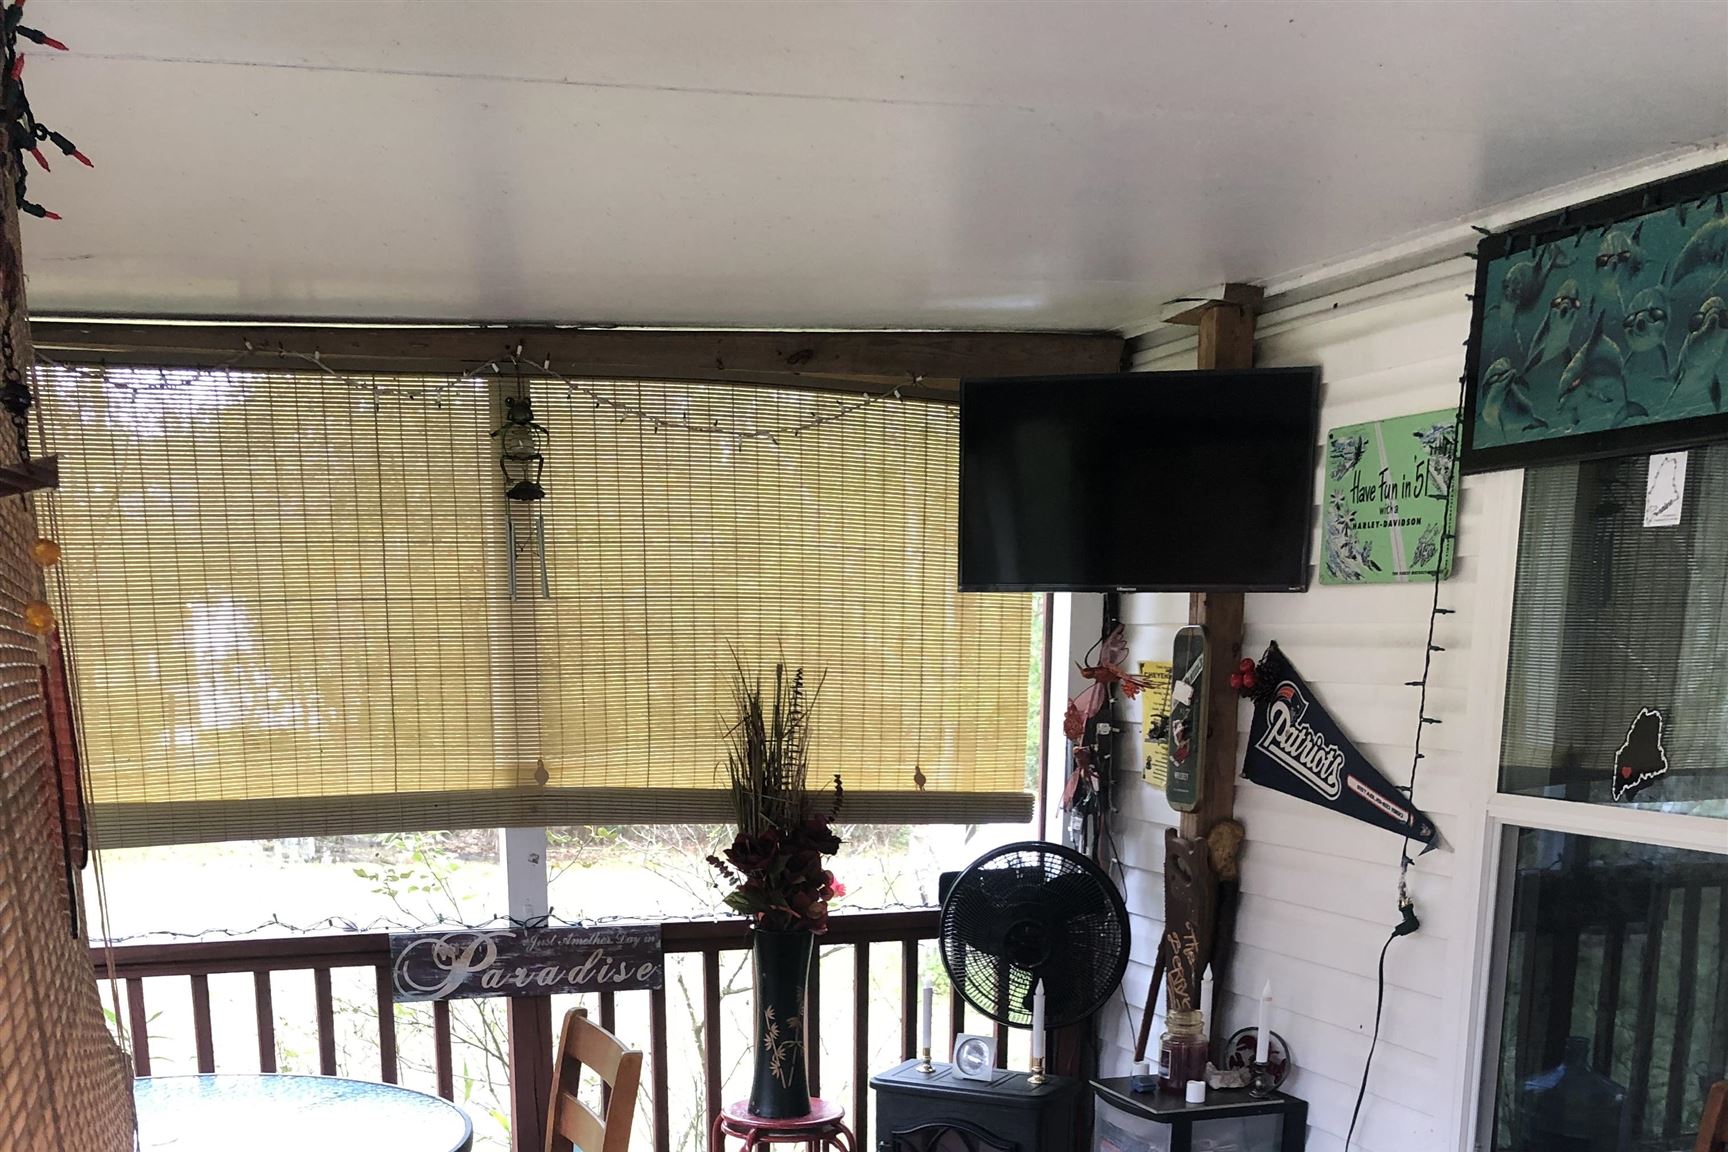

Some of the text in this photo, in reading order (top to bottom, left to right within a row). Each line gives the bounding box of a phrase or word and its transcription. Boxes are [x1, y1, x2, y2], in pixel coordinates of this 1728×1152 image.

[1350, 470, 1376, 504] Have
[1378, 467, 1398, 502] Fun
[1401, 474, 1411, 499] in
[1352, 518, 1422, 530] HARLEY-DAVIDSON
[1262, 700, 1343, 789] Patriots
[522, 934, 557, 951] Just
[558, 932, 613, 945] Another
[615, 933, 640, 947] Day
[393, 931, 660, 1000] Paradise
